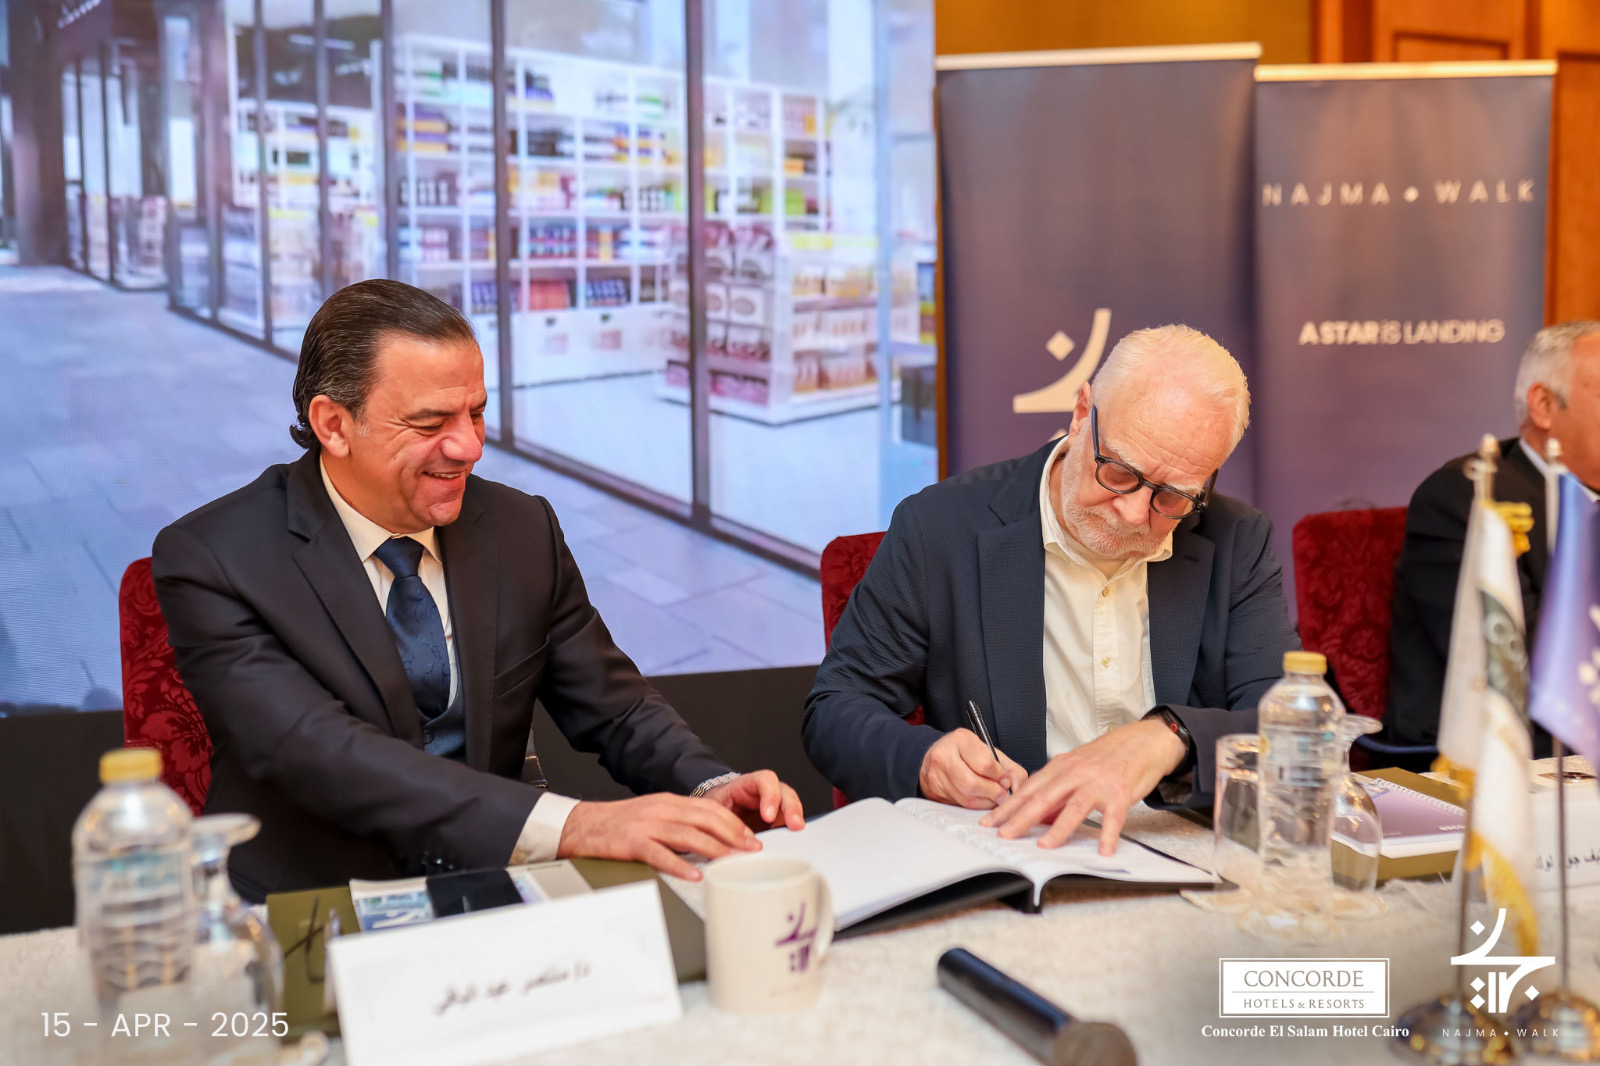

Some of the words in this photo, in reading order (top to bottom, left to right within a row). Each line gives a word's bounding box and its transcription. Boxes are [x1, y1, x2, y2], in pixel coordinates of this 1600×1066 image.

[1261, 182, 1391, 207] NAJMA
[1433, 178, 1536, 204] WALK
[1403, 318, 1506, 345] LANDING
